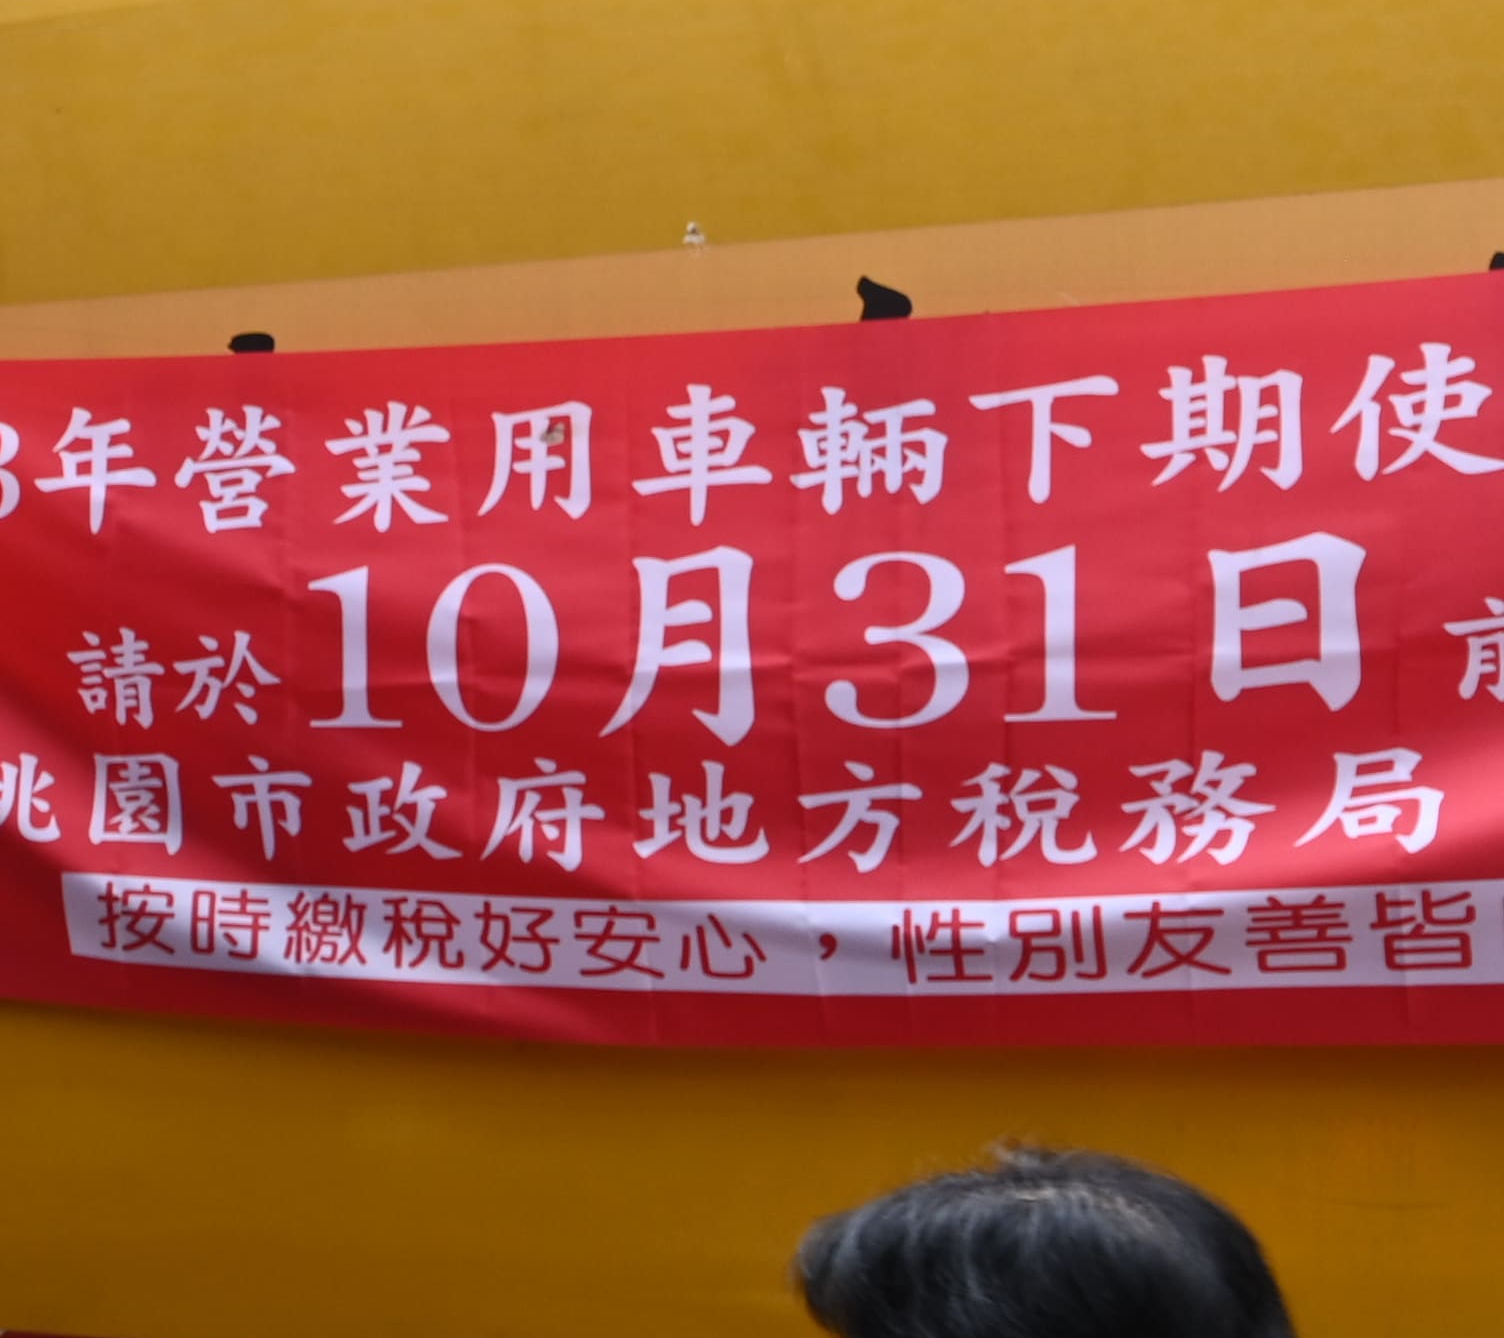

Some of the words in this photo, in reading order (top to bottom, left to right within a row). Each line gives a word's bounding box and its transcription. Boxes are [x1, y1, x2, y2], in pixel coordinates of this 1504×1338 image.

[97, 881, 1504, 983] 按時繳稅好安心，性別友善皆
